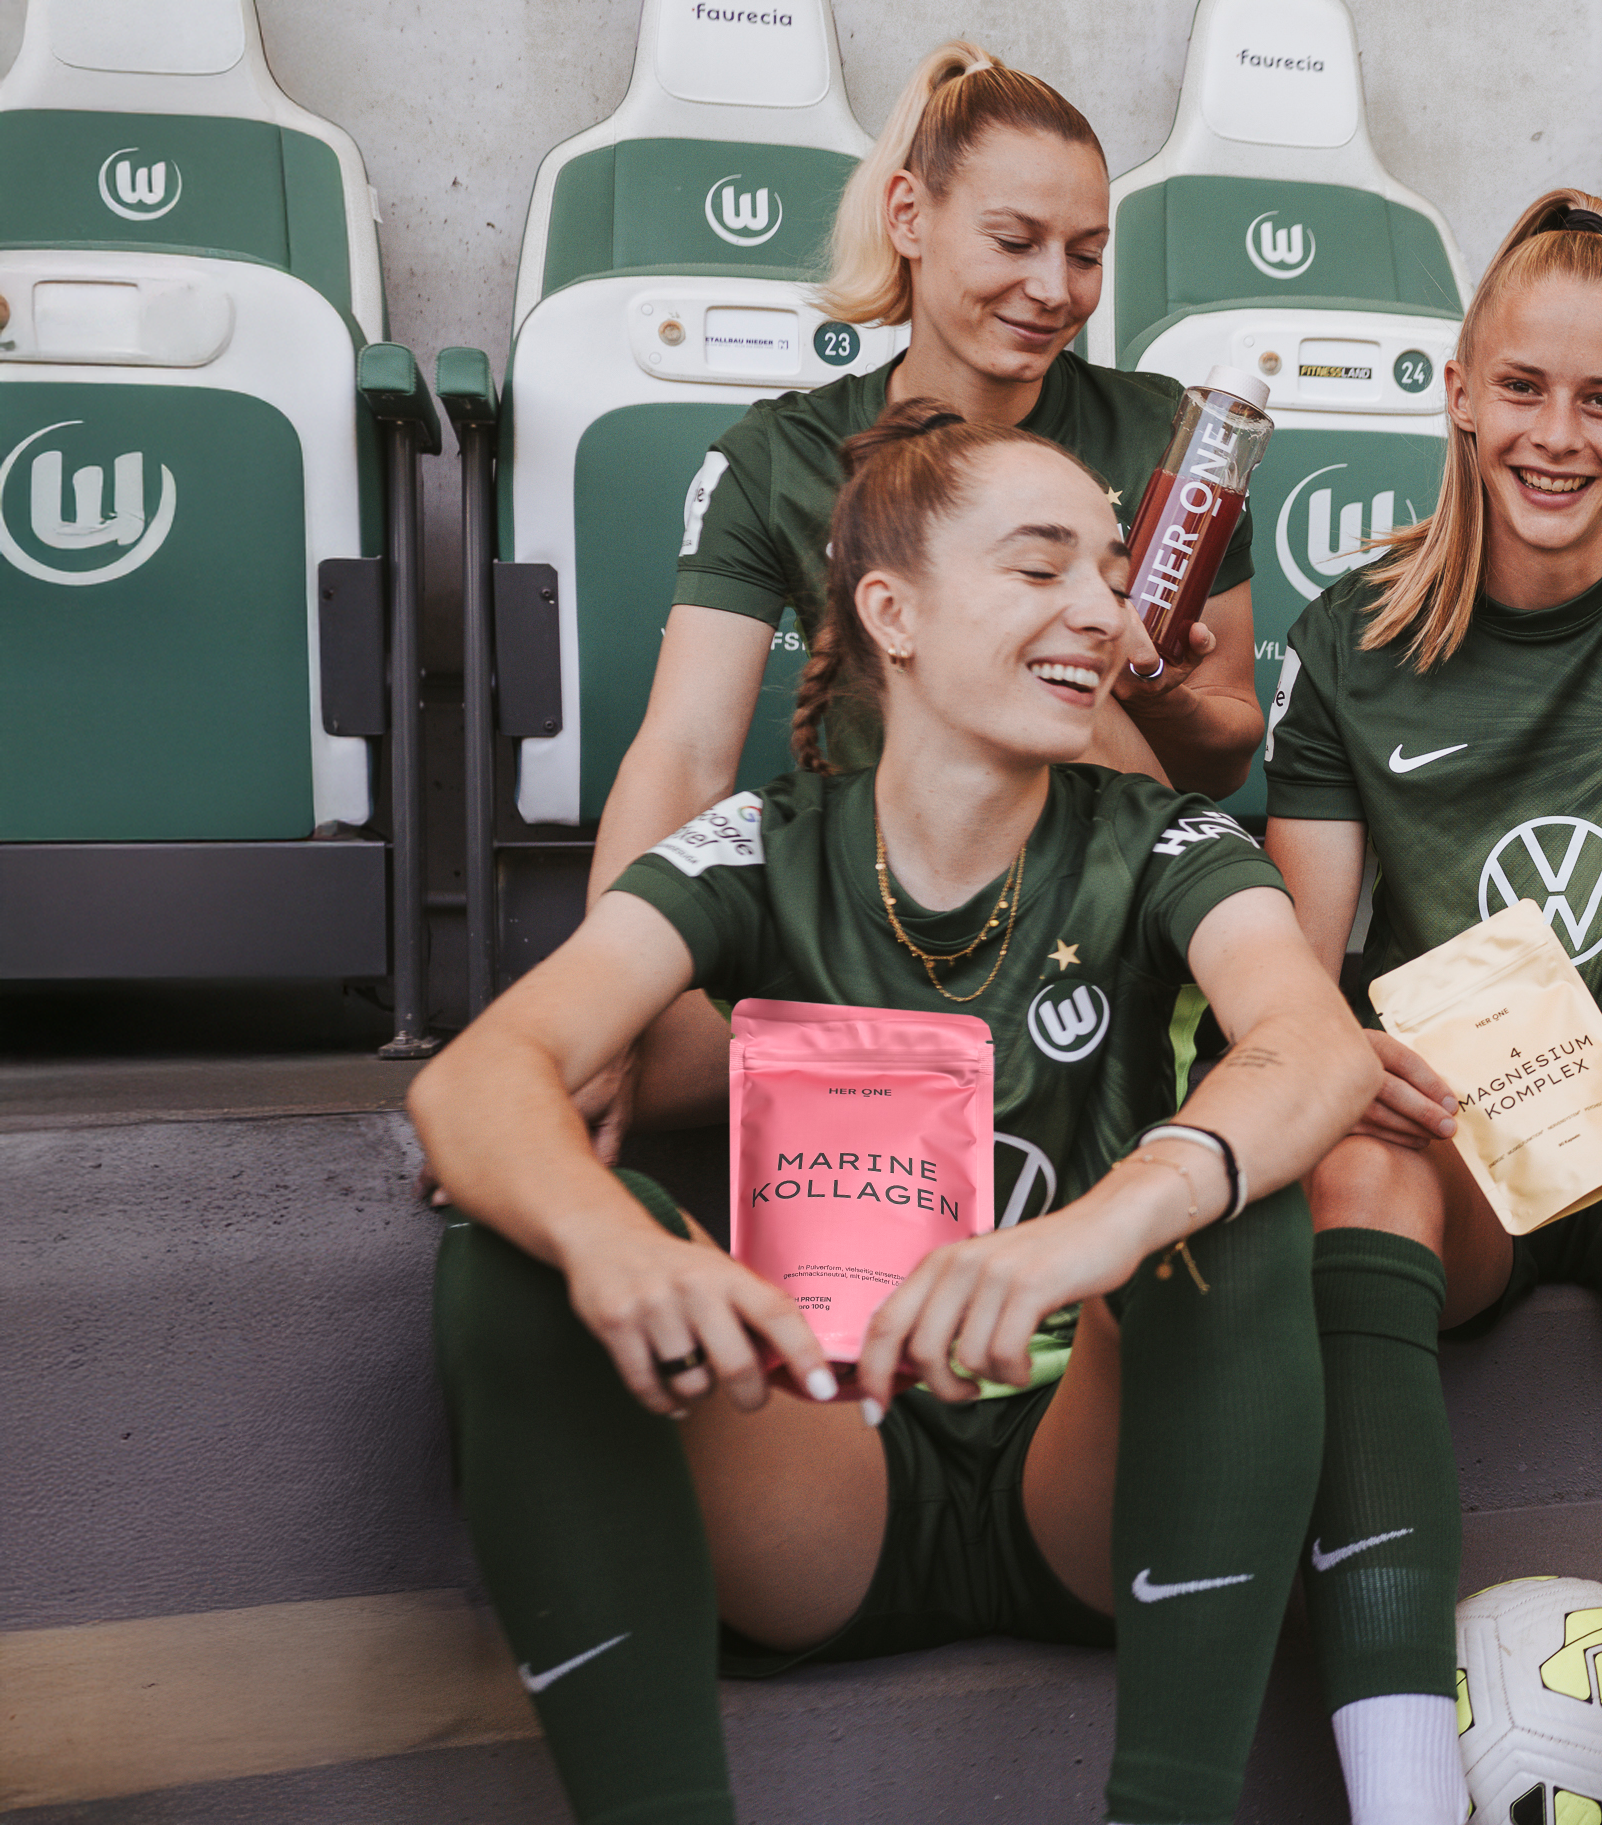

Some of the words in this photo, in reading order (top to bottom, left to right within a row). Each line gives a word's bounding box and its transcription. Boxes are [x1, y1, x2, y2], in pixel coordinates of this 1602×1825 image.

[697, 3, 792, 26] faurecia
[1240, 49, 1325, 73] faurecia
[824, 331, 850, 357] 23
[1300, 366, 1370, 379] FITNESSLAND
[1401, 361, 1426, 385] 24
[1140, 524, 1199, 610] HER
[1180, 422, 1238, 517] ONE
[1254, 640, 1286, 660] VfL
[1475, 1017, 1492, 1029] HER
[1492, 1007, 1510, 1022] ONE
[1510, 1047, 1522, 1059] 4
[1458, 1034, 1594, 1112] MAGNESIUM
[829, 1087, 857, 1096] HER
[861, 1088, 893, 1098] ONE
[1484, 1058, 1590, 1120] KOMPLEX
[777, 1152, 938, 1182] MARINE
[751, 1179, 959, 1222] KOLLAGEN
[783, 1271, 848, 1280] geschmacksneutral,
[861, 1275, 890, 1285] perfekter
[806, 1264, 844, 1272] Pulverform,
[845, 1266, 874, 1276] vielseitig
